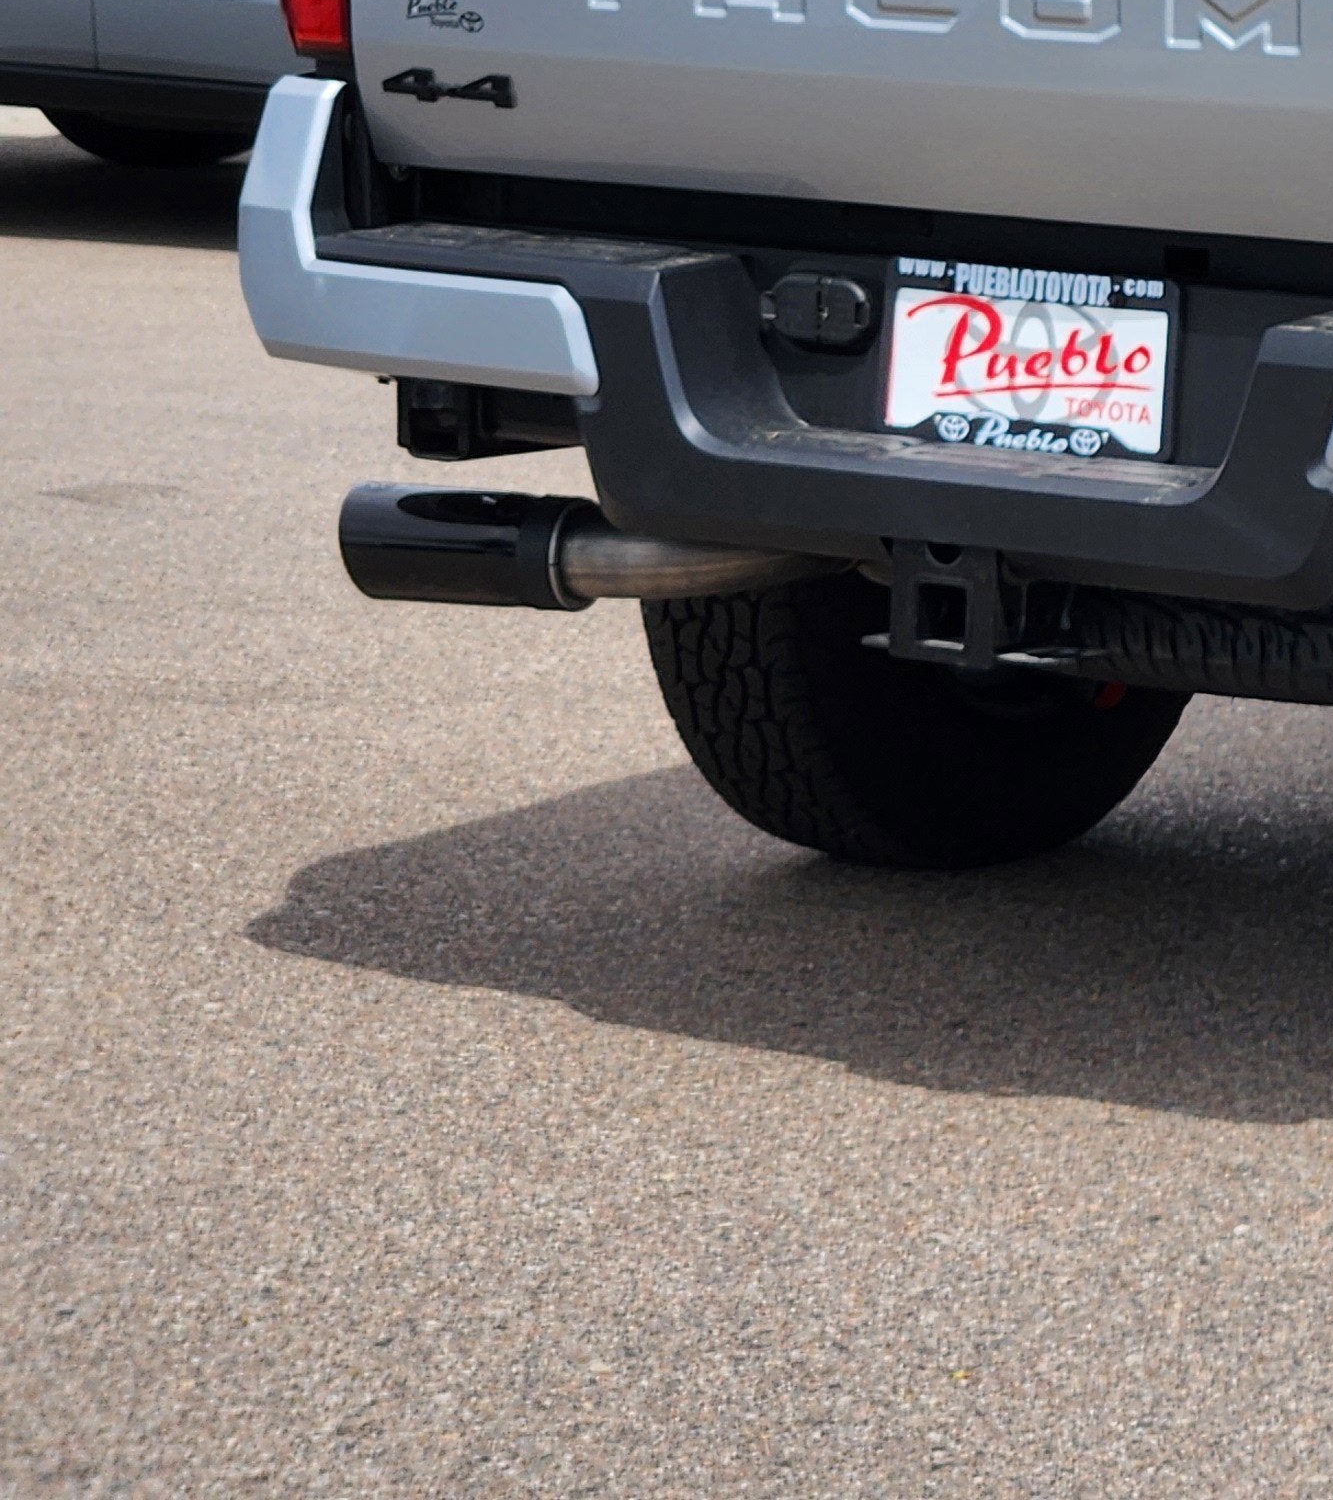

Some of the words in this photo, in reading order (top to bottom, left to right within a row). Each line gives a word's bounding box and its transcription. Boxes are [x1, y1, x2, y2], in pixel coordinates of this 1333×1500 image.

[906, 292, 1153, 386] Pueblo
[970, 410, 1070, 454] Pueblo
[1064, 396, 1153, 426] TOYOTA
